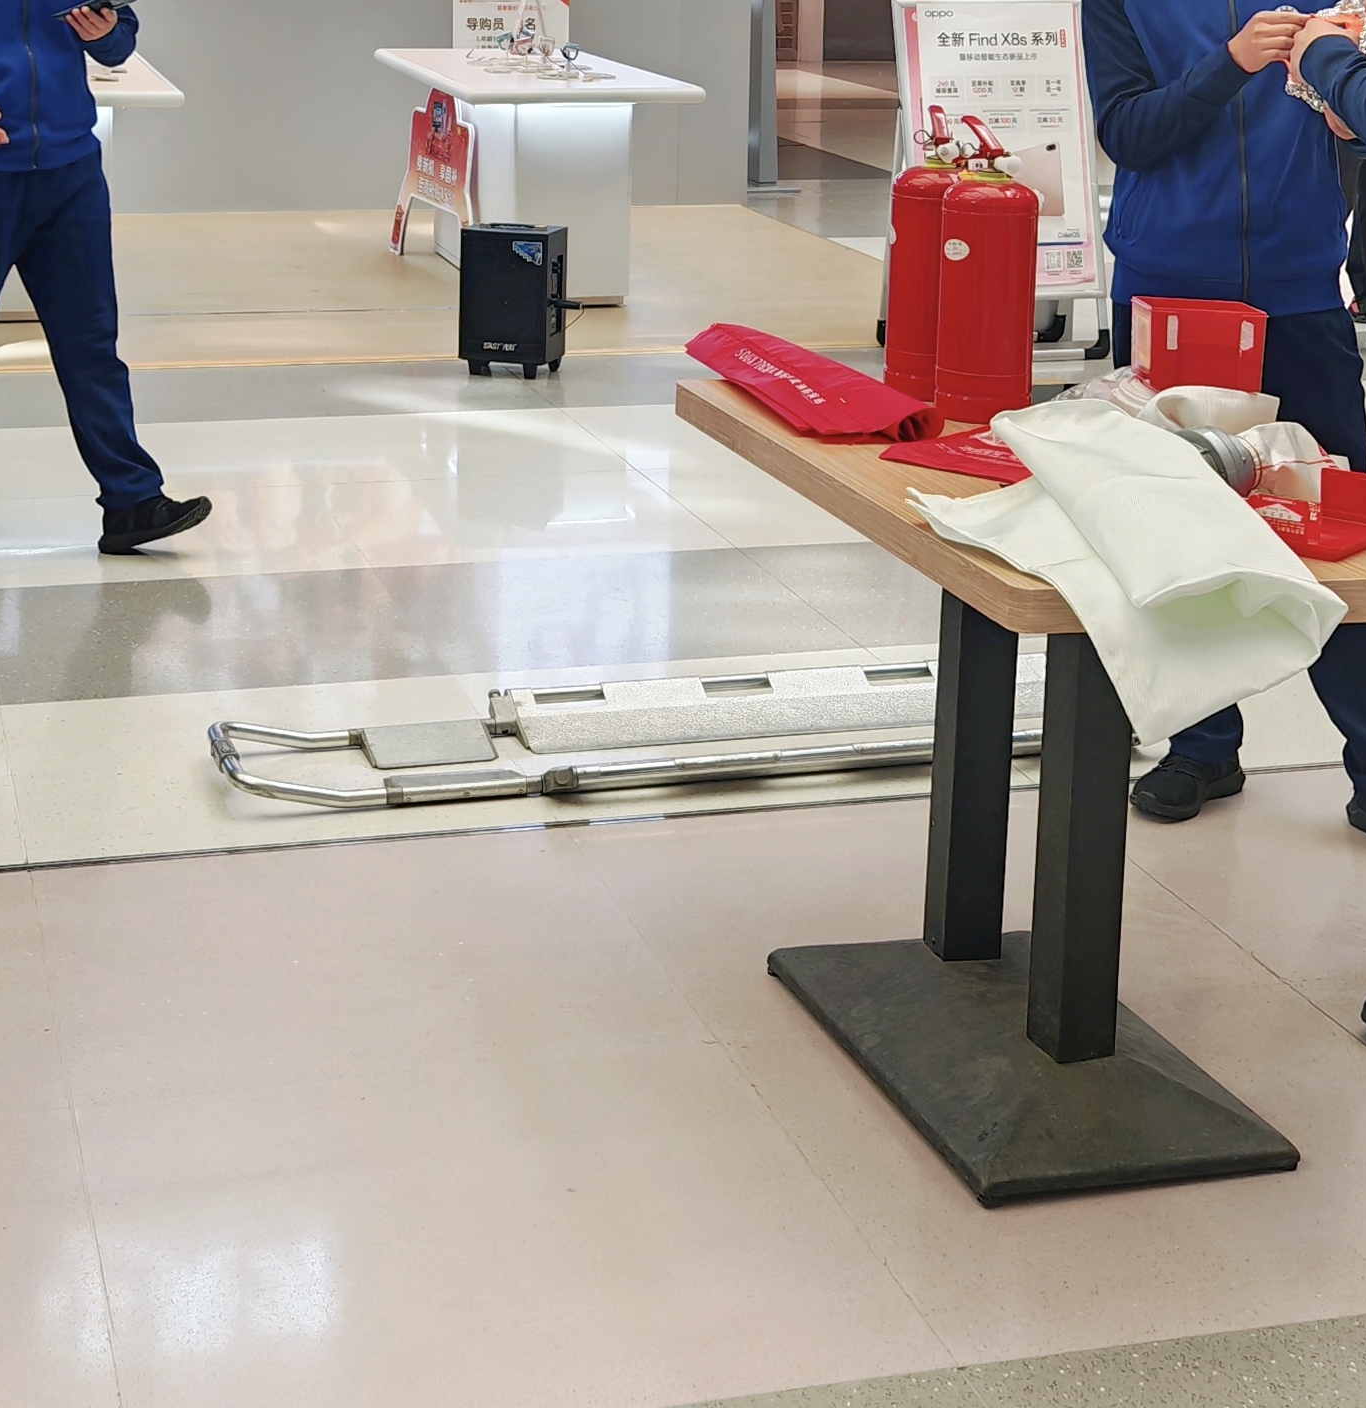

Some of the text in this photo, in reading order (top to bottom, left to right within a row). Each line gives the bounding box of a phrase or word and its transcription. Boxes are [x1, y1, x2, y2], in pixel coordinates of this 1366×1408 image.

[924, 10, 954, 19] oppo
[466, 17, 505, 31] 导购员
[937, 32, 964, 47] 全新
[968, 33, 998, 47] Find
[1001, 33, 1027, 46] X8s
[1031, 32, 1058, 47] 系列
